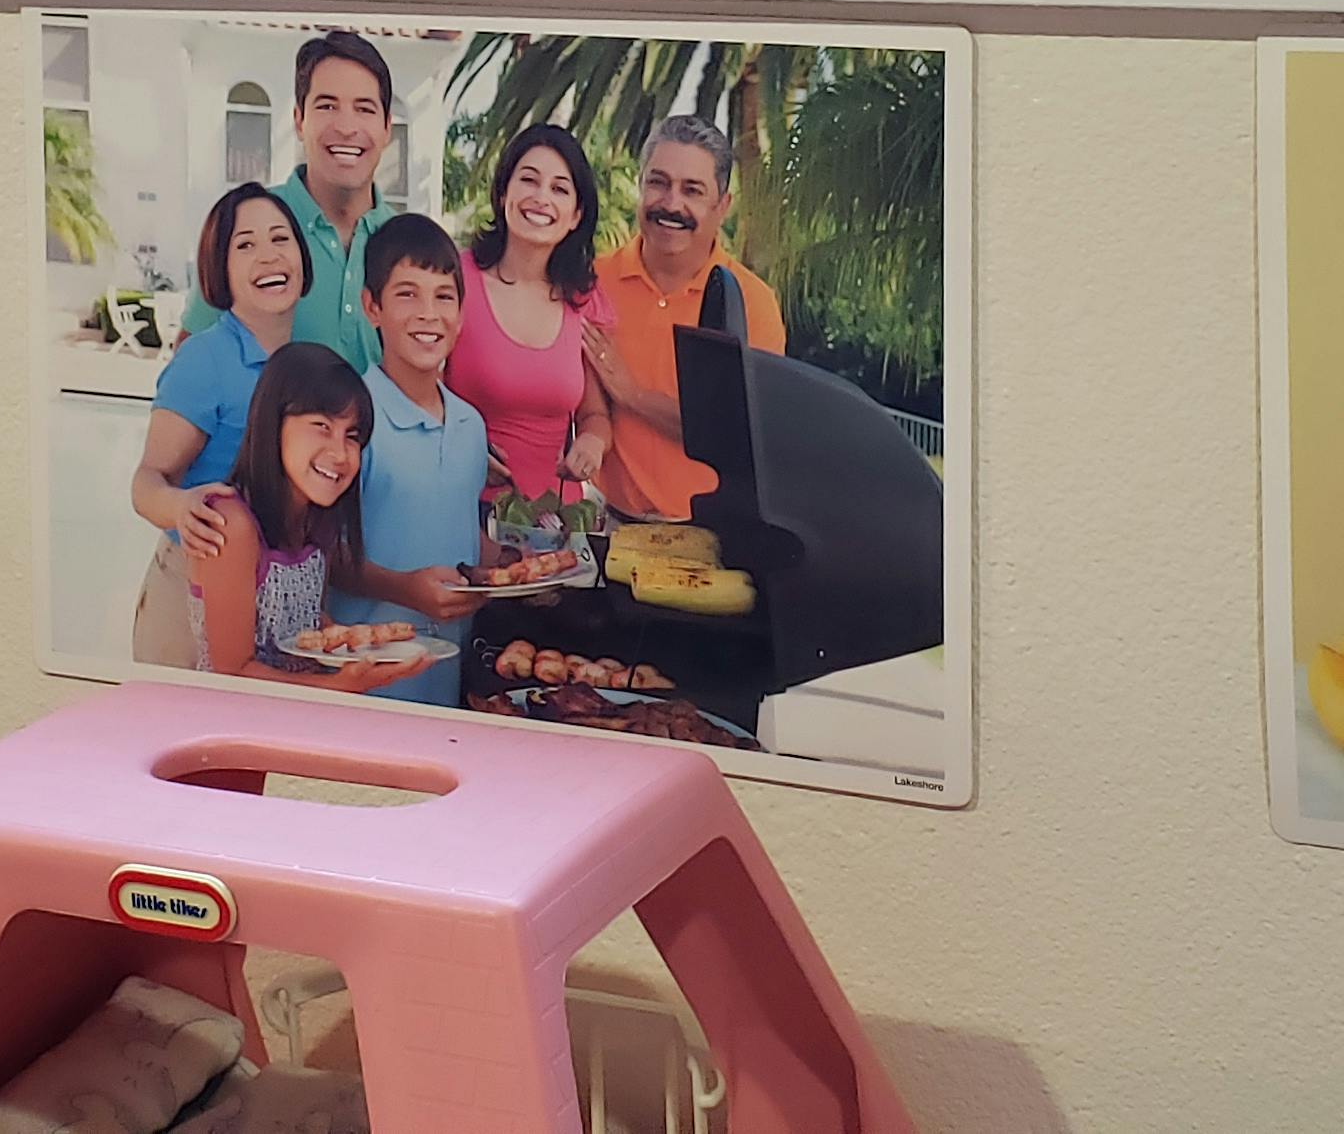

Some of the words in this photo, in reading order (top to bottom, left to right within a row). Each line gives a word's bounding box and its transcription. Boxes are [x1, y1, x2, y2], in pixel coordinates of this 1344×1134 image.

[894, 775, 944, 792] Lakeshore
[131, 892, 166, 913] little
[170, 898, 208, 919] tikes
